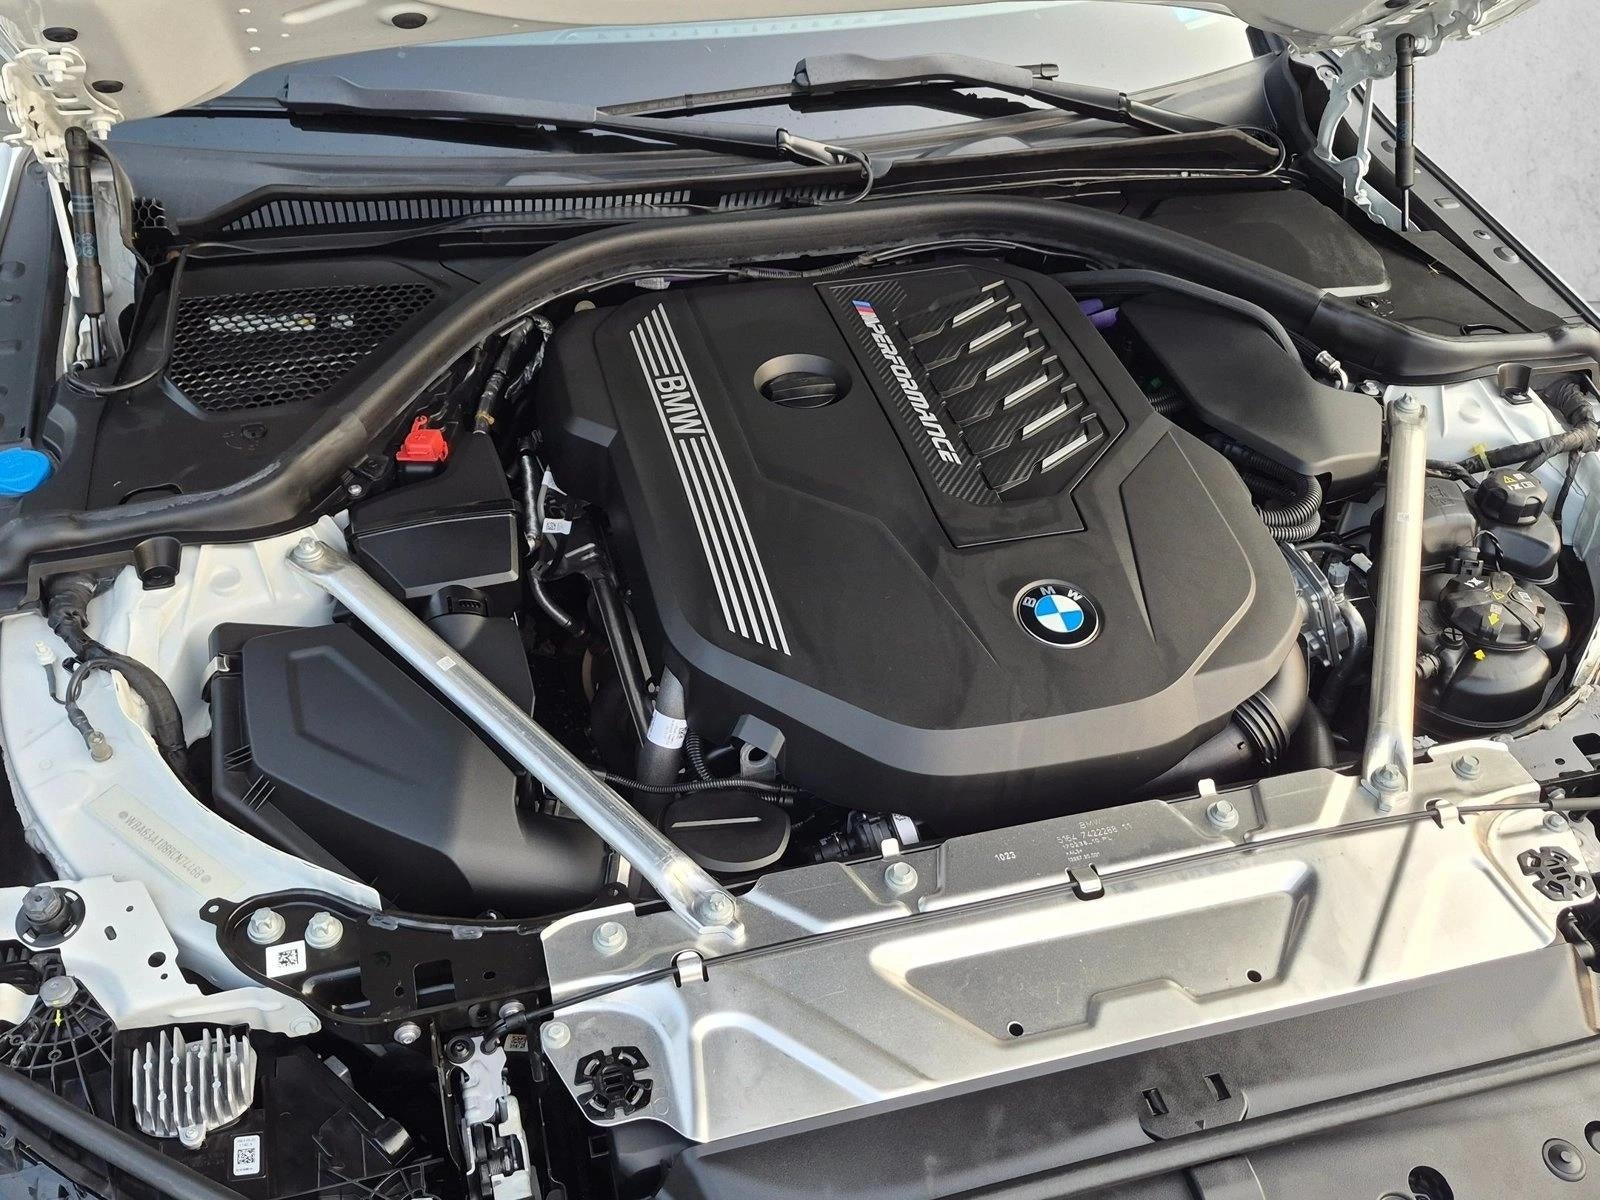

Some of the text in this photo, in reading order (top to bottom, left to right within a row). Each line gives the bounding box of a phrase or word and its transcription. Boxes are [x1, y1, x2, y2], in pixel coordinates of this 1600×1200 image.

[867, 321, 962, 465] PERFORMANCE
[655, 375, 706, 434] BMW
[1022, 585, 1083, 608] BMW
[1056, 833, 1078, 844] 5164
[1080, 825, 1118, 839] 7422288
[1079, 819, 1101, 829] BMW
[994, 851, 1016, 861] 1023
